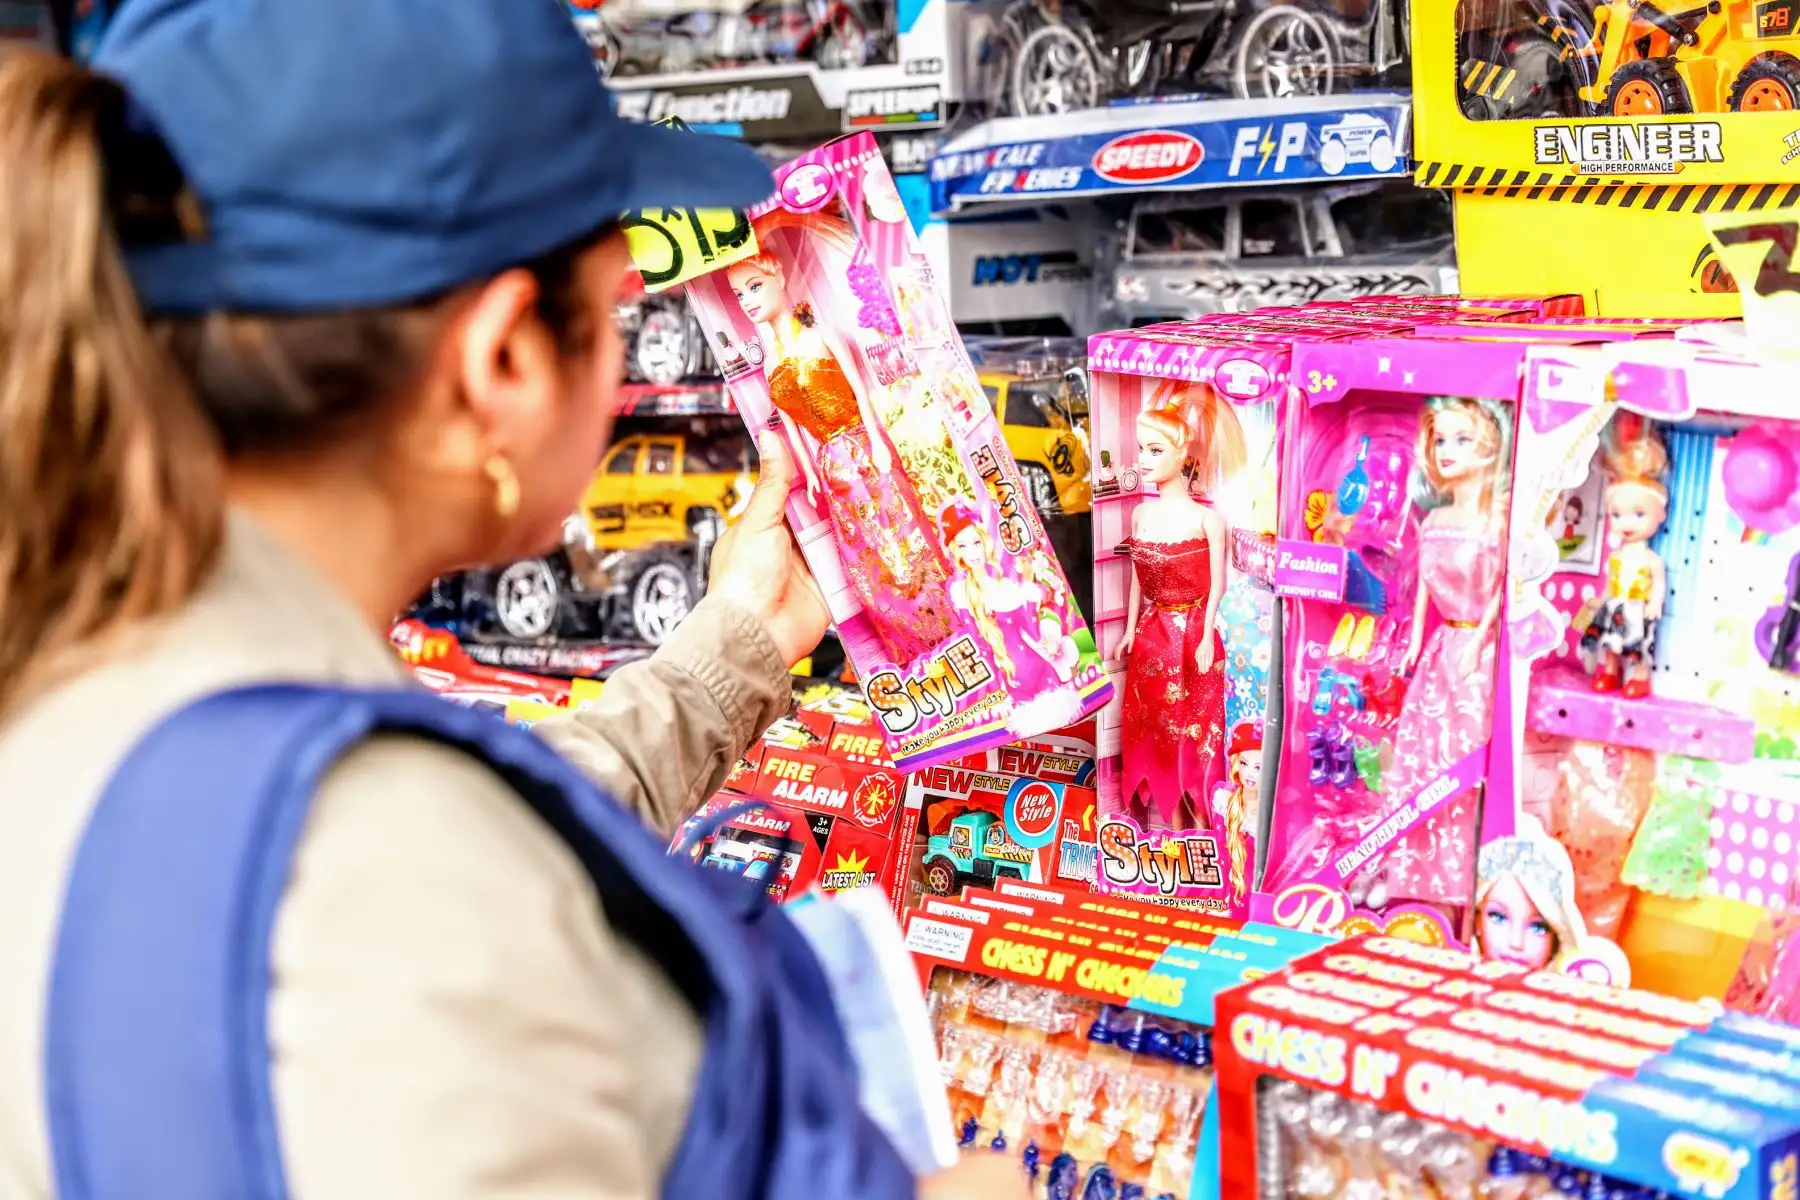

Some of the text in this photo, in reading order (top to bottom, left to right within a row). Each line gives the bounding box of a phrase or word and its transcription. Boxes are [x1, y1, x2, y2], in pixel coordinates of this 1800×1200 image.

[1534, 122, 1724, 164] ENGINEER
[1100, 141, 1194, 172] SPEEDY
[1580, 162, 1674, 173] HIGH PERFORMANCE
[971, 252, 1046, 287] HOT
[1308, 369, 1337, 393] 3+
[1278, 551, 1339, 576] Fashion
[831, 733, 882, 757] FIRE
[764, 758, 816, 783] FIRE
[1042, 755, 1080, 772] STYLE
[914, 768, 1010, 793] NEW STYLE
[772, 782, 849, 809] ALARM
[1020, 793, 1049, 808] New
[734, 812, 791, 832] ALARM
[817, 816, 829, 826] 3+
[1020, 805, 1052, 823] Style
[812, 825, 829, 835] AGES
[899, 827, 908, 851] PHOTOS
[1063, 820, 1080, 839] The
[821, 871, 876, 888] LATEST LIST
[1180, 897, 1206, 910] every
[924, 925, 965, 942] WARNING
[981, 937, 1045, 980] CHESS
[1230, 1012, 1348, 1086] CHESS
